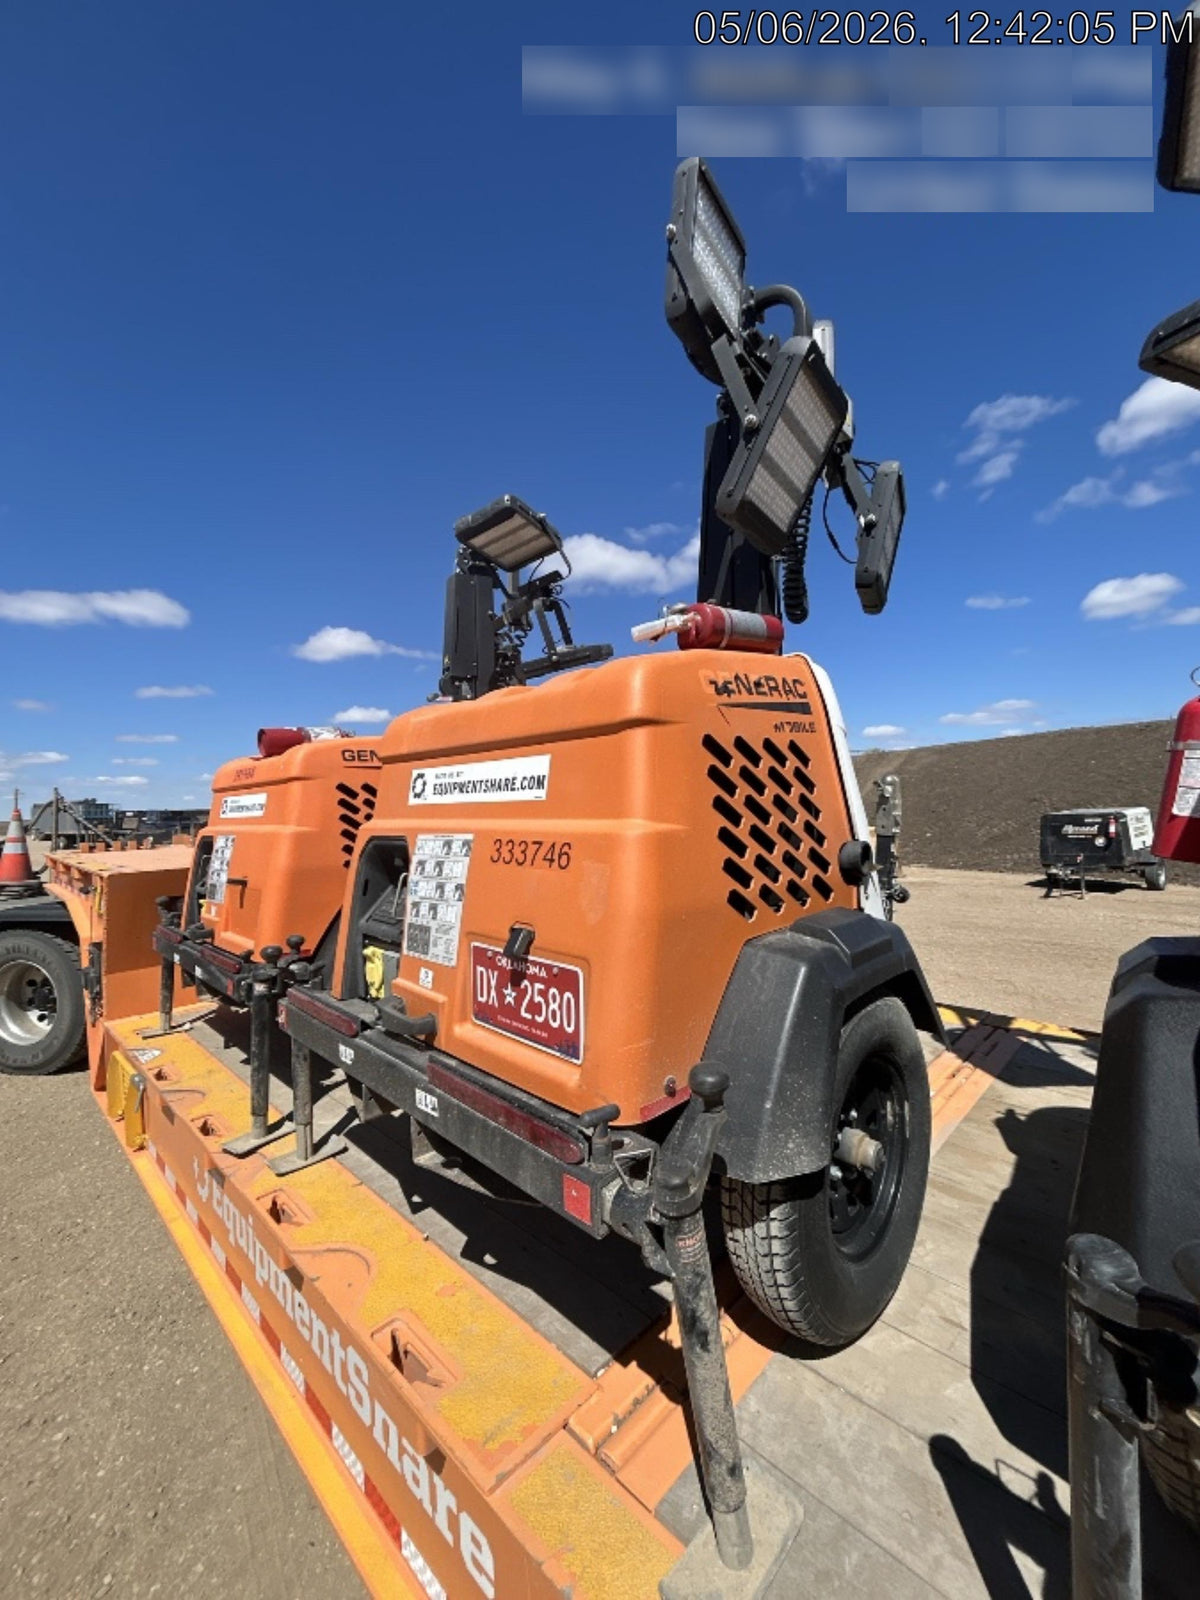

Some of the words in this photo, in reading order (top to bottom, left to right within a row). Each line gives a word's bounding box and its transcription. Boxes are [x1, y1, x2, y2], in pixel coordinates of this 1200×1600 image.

[701, 671, 808, 700] ENERAC
[432, 774, 546, 796] EQUIPMENTSHARE.COM
[490, 838, 572, 870] 333746
[495, 956, 548, 978] OKLAHOMA
[476, 965, 498, 1008] DX
[520, 979, 576, 1034] 2580
